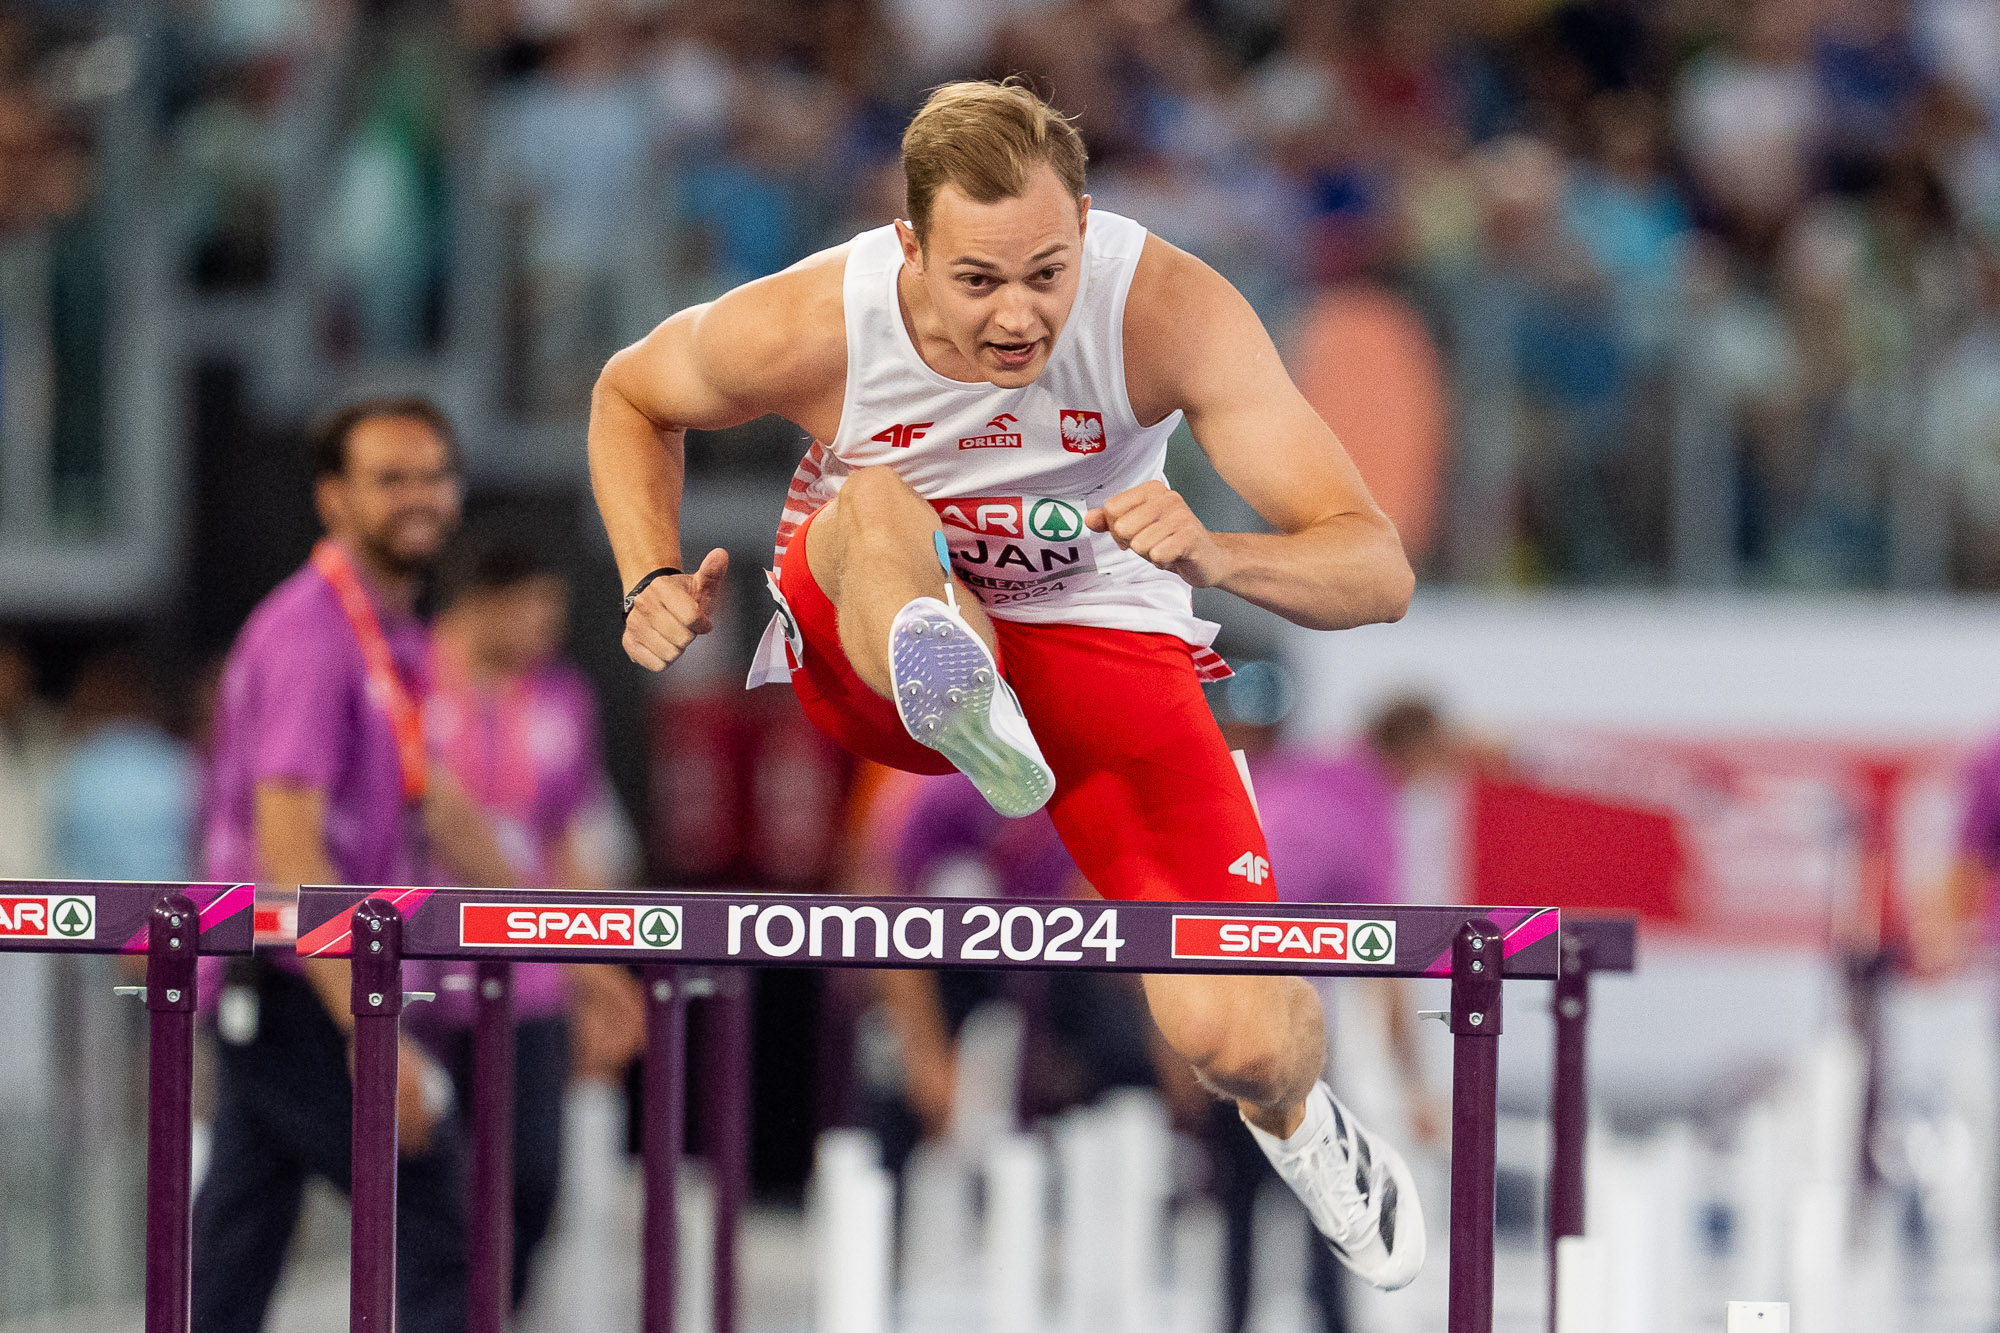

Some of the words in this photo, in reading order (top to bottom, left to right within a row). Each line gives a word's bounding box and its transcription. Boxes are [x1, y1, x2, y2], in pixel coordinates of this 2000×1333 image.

[871, 421, 935, 448] 4F
[962, 435, 1018, 448] ORLEN
[950, 540, 1080, 572] JAN
[993, 582, 1067, 605] 2024
[1228, 851, 1269, 885] 4F
[507, 911, 631, 941] SPAR
[728, 904, 944, 960] roma
[960, 905, 1126, 963] 2024
[1219, 924, 1345, 955] SPAR
